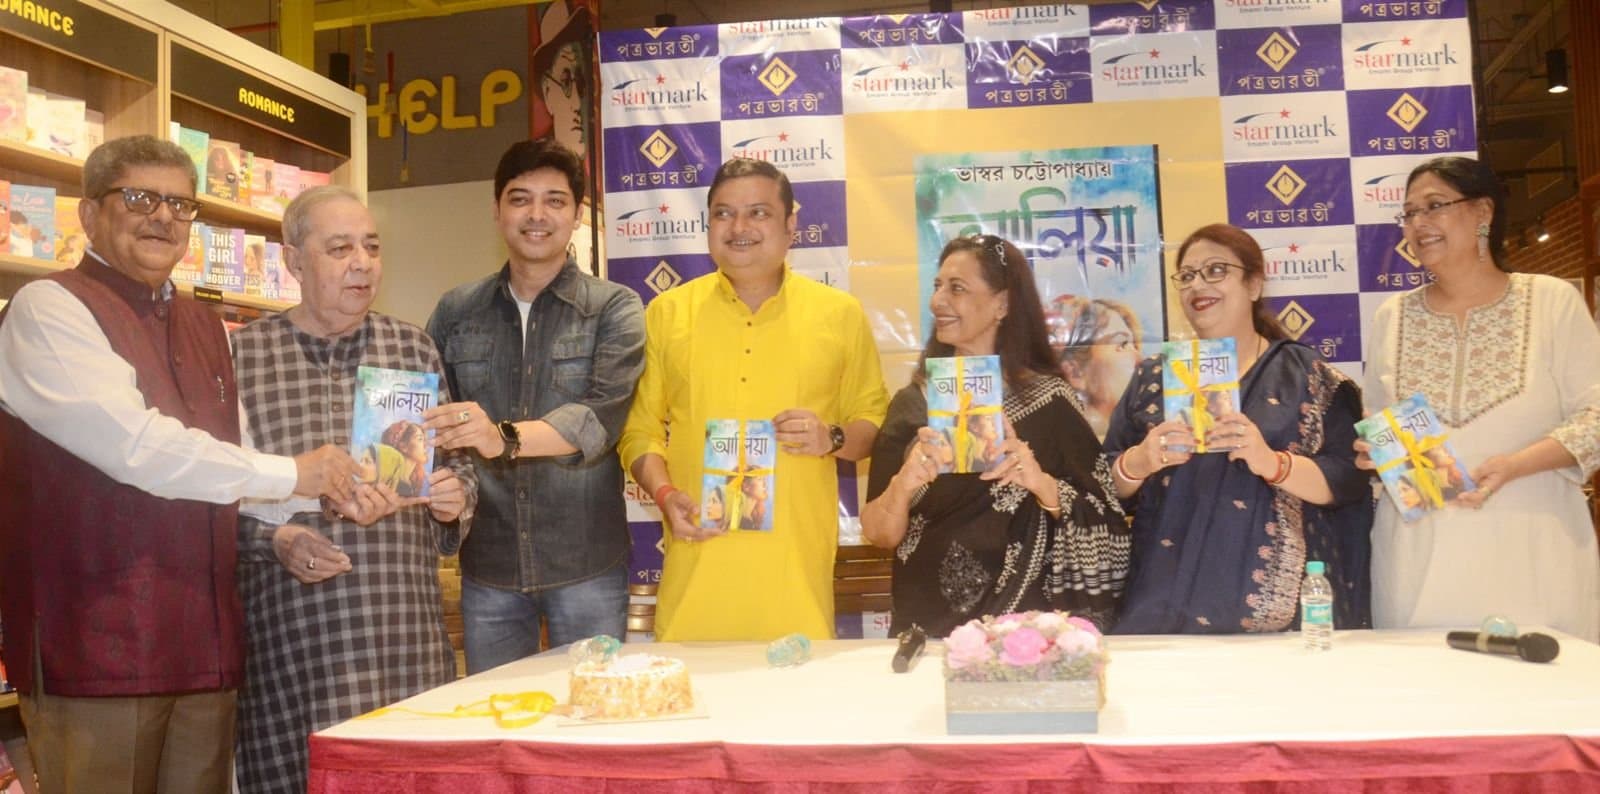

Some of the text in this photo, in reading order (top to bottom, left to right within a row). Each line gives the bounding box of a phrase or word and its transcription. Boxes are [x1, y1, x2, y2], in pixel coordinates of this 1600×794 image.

[0, 0, 75, 36] OMANCE
[1102, 55, 1206, 81] starmark
[1353, 43, 1458, 68] starmark
[853, 69, 955, 92] starmark
[238, 87, 295, 124] ROMANCE
[355, 69, 523, 138] HELP
[611, 81, 708, 106] starmark
[1233, 115, 1337, 141] starmark
[956, 164, 1005, 182] ভাস্বর
[210, 232, 237, 248] THIS
[207, 248, 238, 265] GIRL
